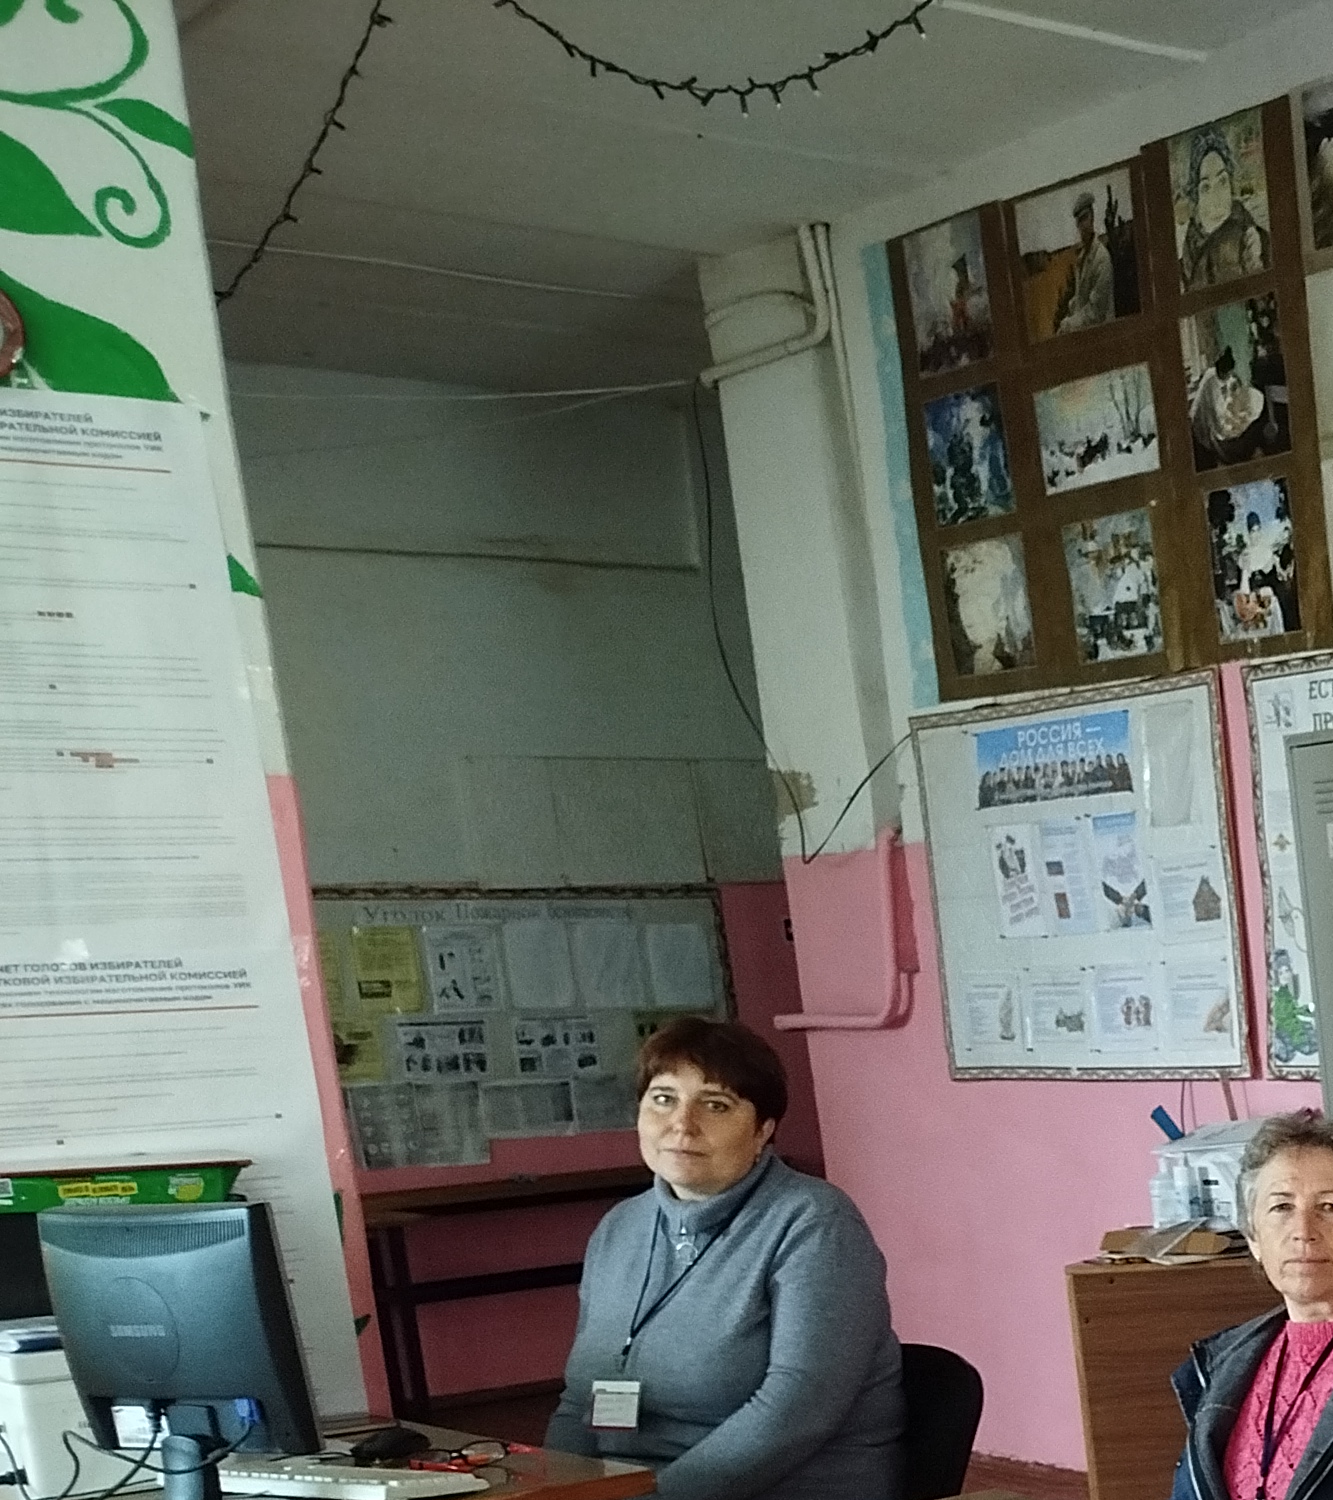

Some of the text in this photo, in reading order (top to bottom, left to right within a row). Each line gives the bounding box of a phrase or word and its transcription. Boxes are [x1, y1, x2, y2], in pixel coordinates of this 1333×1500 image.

[81, 427, 162, 441] КОМИССИЕЙ
[1017, 722, 1082, 747] РОССИЯ
[1035, 744, 1065, 763] ДЛЯ
[1068, 738, 1105, 757] ВСЕХ
[90, 957, 183, 970] ИЗБИРАТЕЛЕЙ
[52, 971, 167, 985] ИЗБИРАТЕЛЬНОЙ
[170, 969, 247, 981] КОМИССИЕЙ
